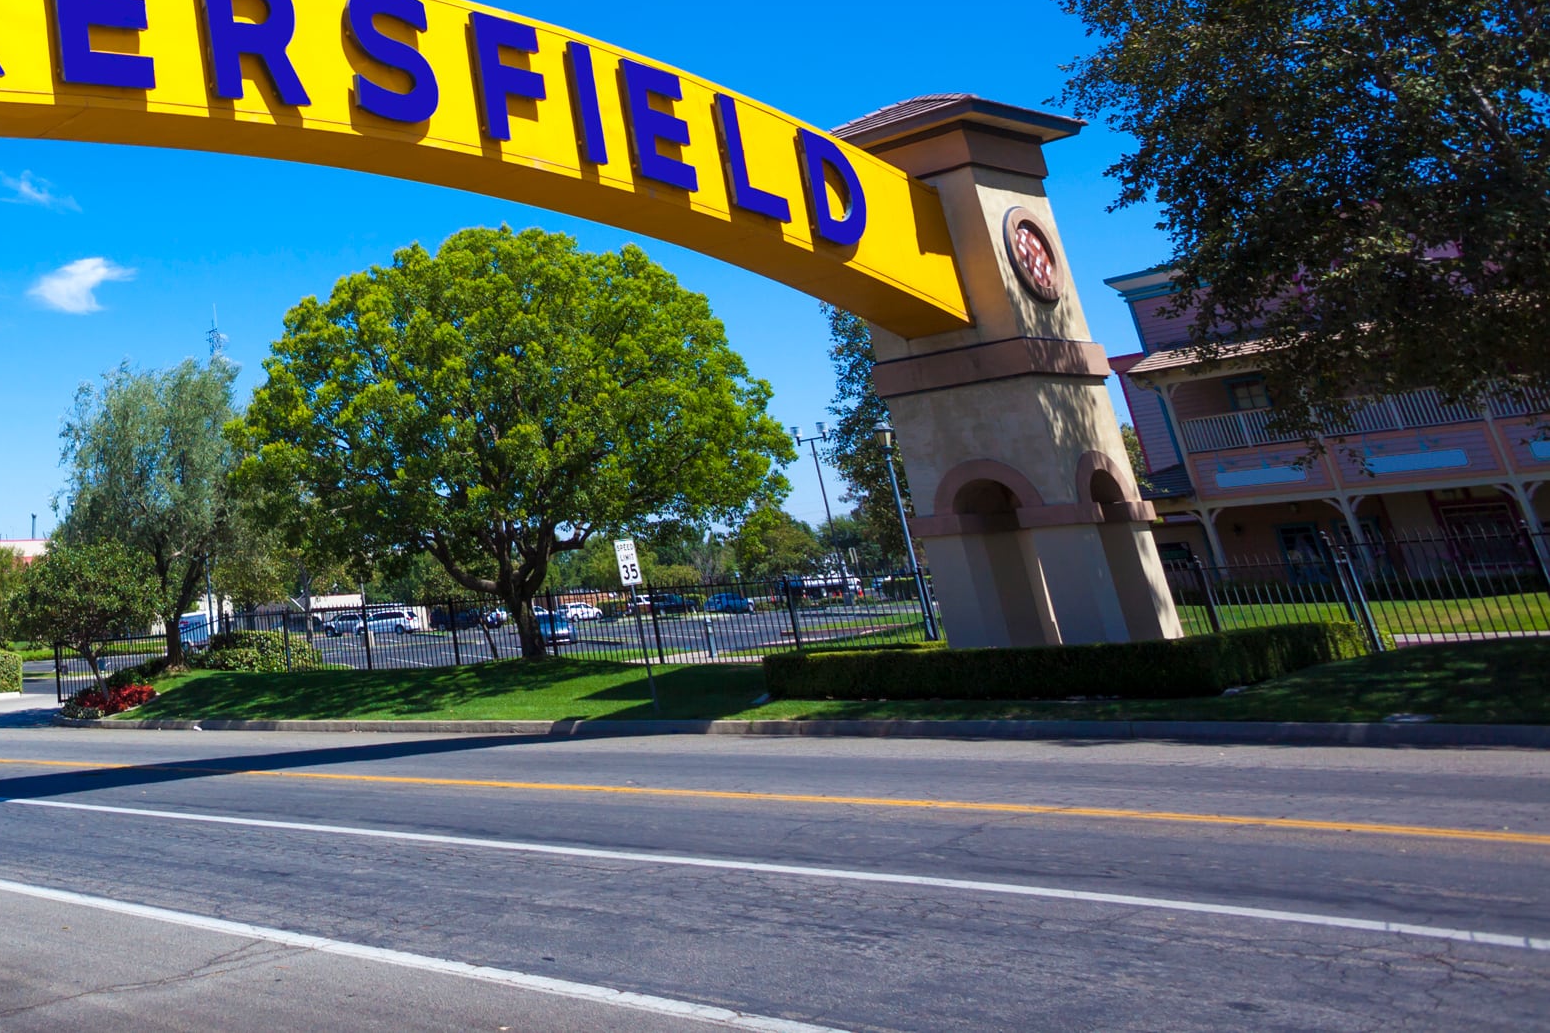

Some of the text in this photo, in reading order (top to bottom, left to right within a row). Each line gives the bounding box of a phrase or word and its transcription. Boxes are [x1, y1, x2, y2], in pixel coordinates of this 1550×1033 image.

[616, 543, 634, 552] SPEED
[620, 553, 634, 562] LIMIT
[622, 563, 638, 580] 35
